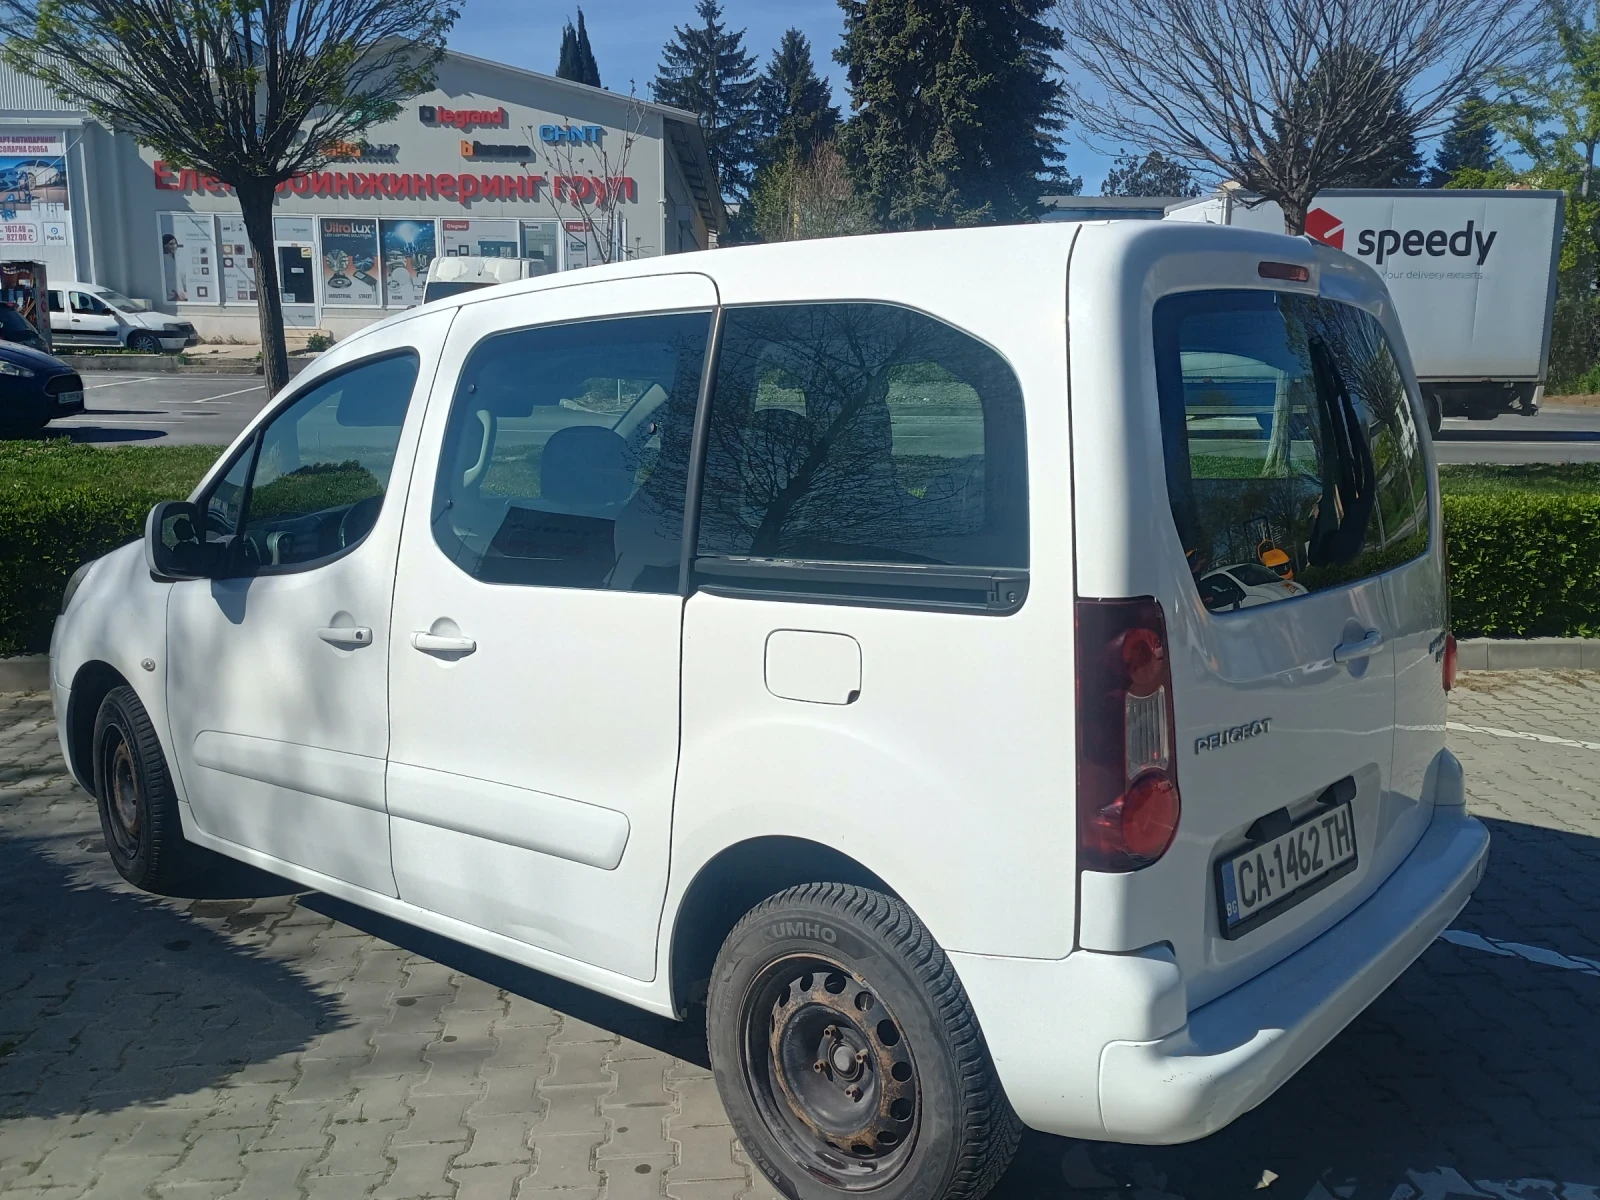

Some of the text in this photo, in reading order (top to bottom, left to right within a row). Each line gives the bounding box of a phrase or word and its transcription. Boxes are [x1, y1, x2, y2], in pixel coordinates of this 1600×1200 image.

[437, 105, 504, 128] legrand
[1357, 220, 1498, 266] speedy
[1381, 270, 1483, 281] Your delivery experts
[1195, 717, 1272, 755] PEUGEOT
[1226, 900, 1238, 917] BG
